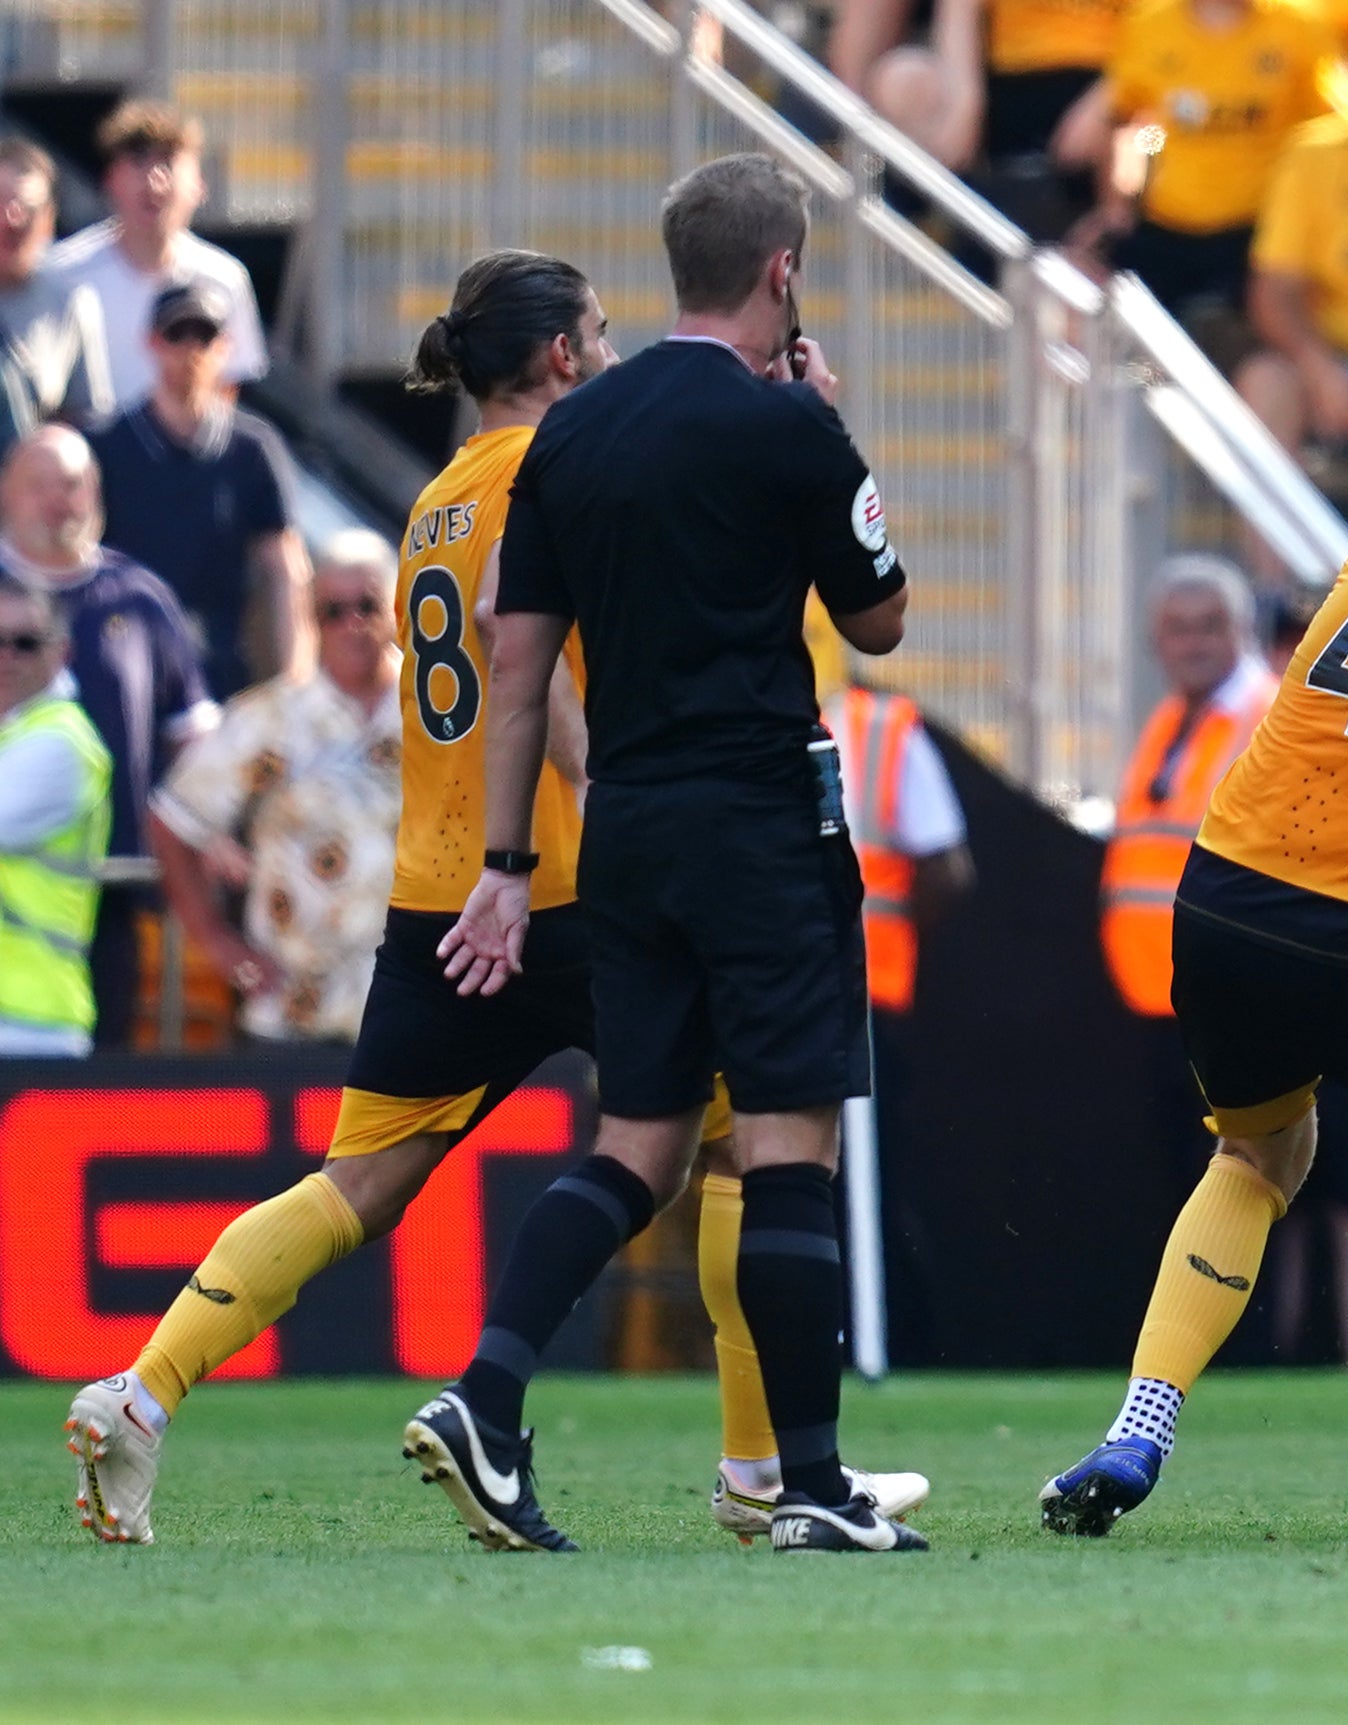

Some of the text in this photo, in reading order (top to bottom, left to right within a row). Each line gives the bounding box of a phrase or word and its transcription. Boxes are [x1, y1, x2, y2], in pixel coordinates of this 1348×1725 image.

[408, 565, 481, 744] 8
[0, 1086, 573, 1381] ET
[771, 1516, 812, 1546] NIKE
